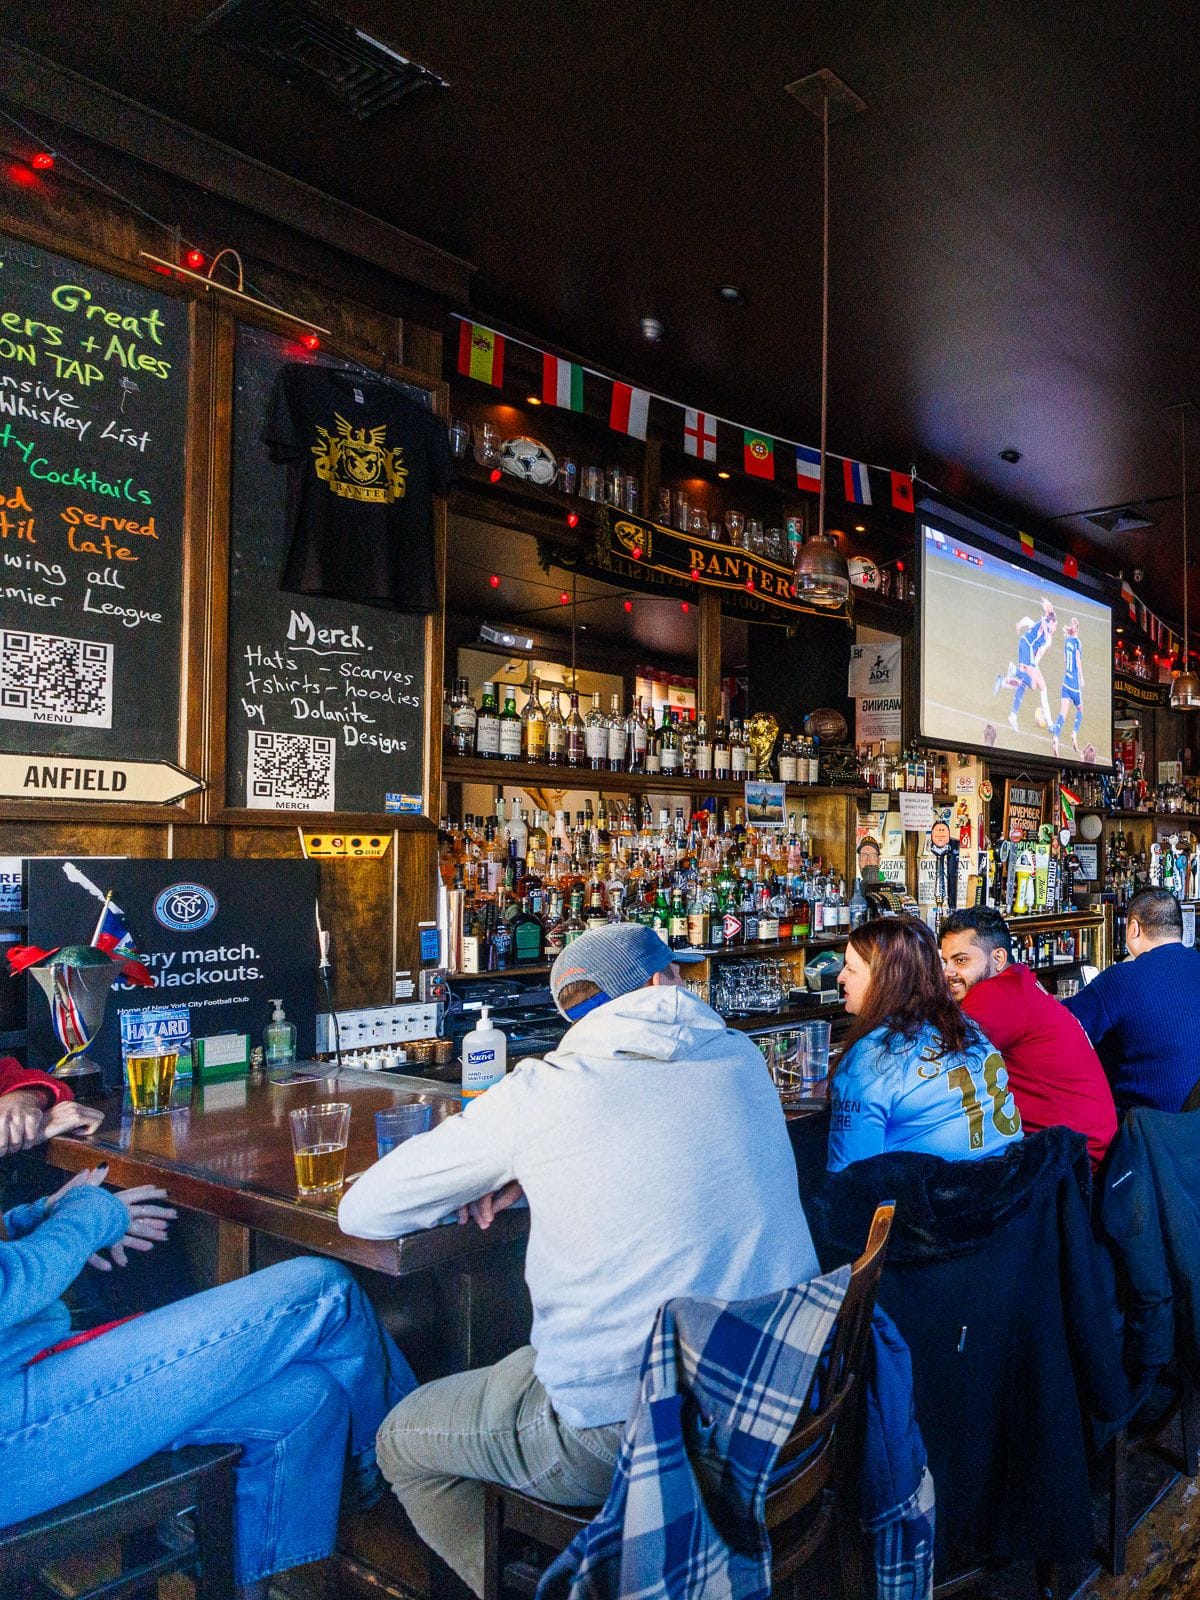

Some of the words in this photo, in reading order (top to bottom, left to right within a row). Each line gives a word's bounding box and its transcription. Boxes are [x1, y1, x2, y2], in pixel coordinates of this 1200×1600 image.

[52, 285, 165, 345] Great
[1, 313, 63, 345] ers
[80, 336, 101, 352] +
[104, 335, 172, 379] Ales
[0, 338, 36, 366] ON
[45, 352, 104, 386] TAP
[1, 376, 80, 408] nsive
[0, 391, 92, 441] Whiskey
[100, 421, 151, 452] List
[0, 424, 35, 462] ty
[30, 458, 151, 504] Cocktails
[0, 511, 36, 543] til
[68, 527, 140, 560] late
[4, 554, 66, 586] wing
[87, 568, 125, 590] all
[689, 548, 793, 599] BANTER
[83, 588, 162, 627] League
[286, 610, 373, 651] Merch.
[244, 645, 298, 670] Hats
[339, 662, 414, 686] scarves
[345, 680, 420, 708] hoodies
[33, 712, 73, 724] MENU
[241, 698, 265, 725] by
[291, 698, 376, 723] Dolanite
[343, 725, 407, 753] Designs
[23, 765, 127, 792] ANFIELD
[275, 801, 310, 810] MERCH
[1009, 804, 1040, 820] NOVEMBER
[1048, 861, 1057, 887] CITIZEN
[1046, 887, 1055, 907] CIDER
[140, 952, 176, 968] ery
[182, 944, 260, 964] match.
[117, 1007, 141, 1015] Home
[152, 1004, 169, 1012] New
[188, 1001, 203, 1009] City
[204, 997, 232, 1006] Football
[127, 1019, 188, 1040] HAZARD
[470, 1052, 494, 1062] Suave
